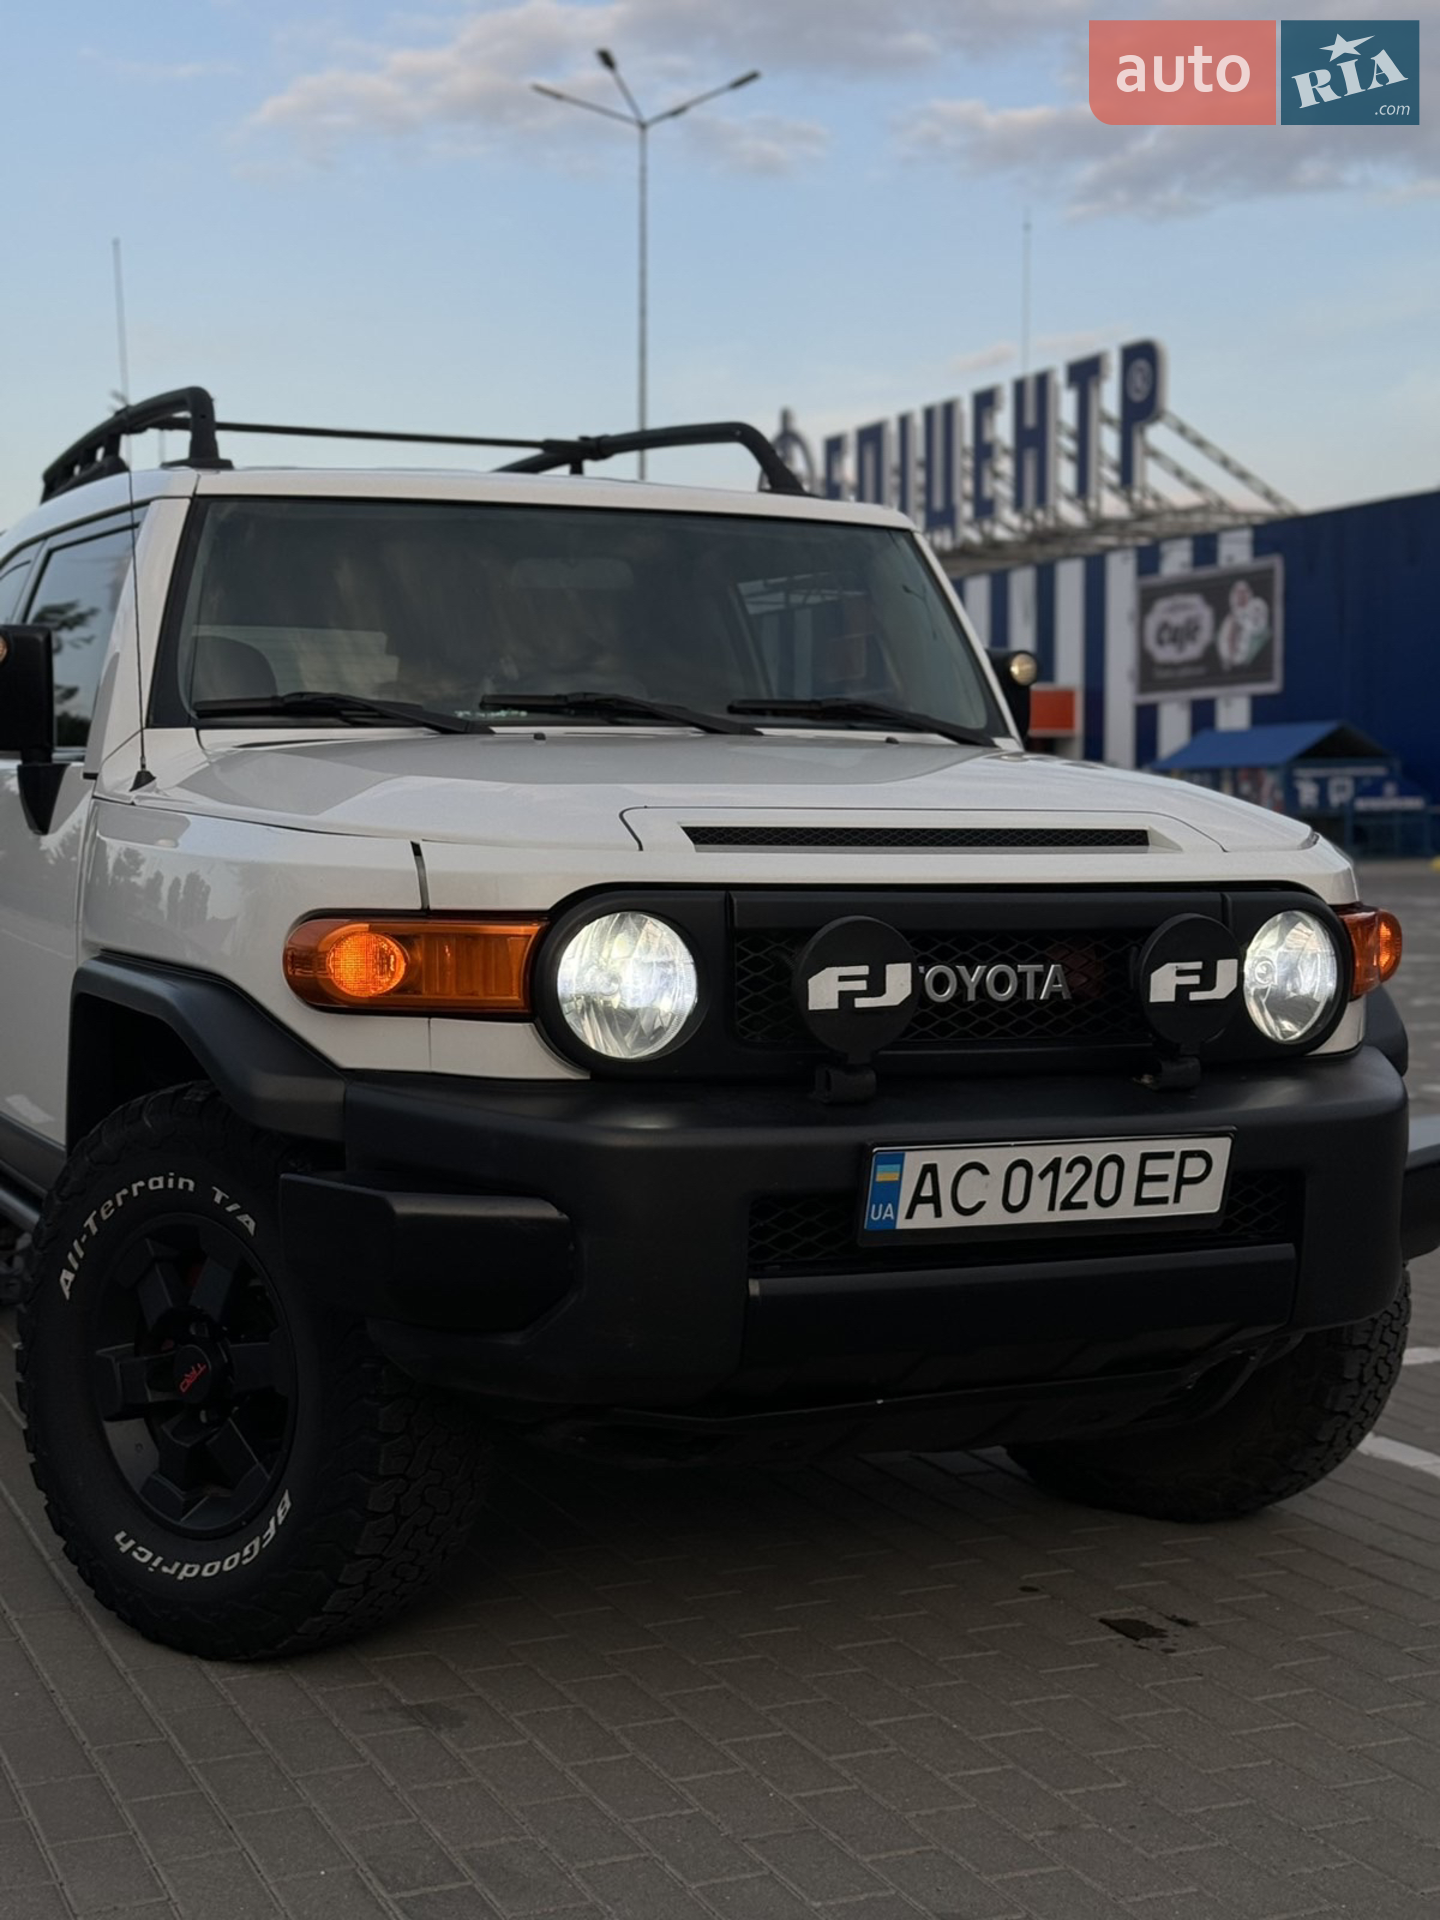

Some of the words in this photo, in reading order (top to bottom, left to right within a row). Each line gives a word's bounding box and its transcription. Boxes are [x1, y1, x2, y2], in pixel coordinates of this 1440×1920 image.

[807, 962, 912, 1010] FJ
[918, 963, 1072, 1003] OYOTA
[1149, 958, 1239, 1003] FJ
[904, 1160, 990, 1220] AC
[1001, 1153, 1125, 1214] 0120
[1133, 1149, 1213, 1207] EP
[870, 1202, 895, 1221] UA
[59, 1172, 195, 1300] All-Terrain
[211, 1186, 257, 1236] T/A
[114, 1489, 292, 1581] BFGoodrich
